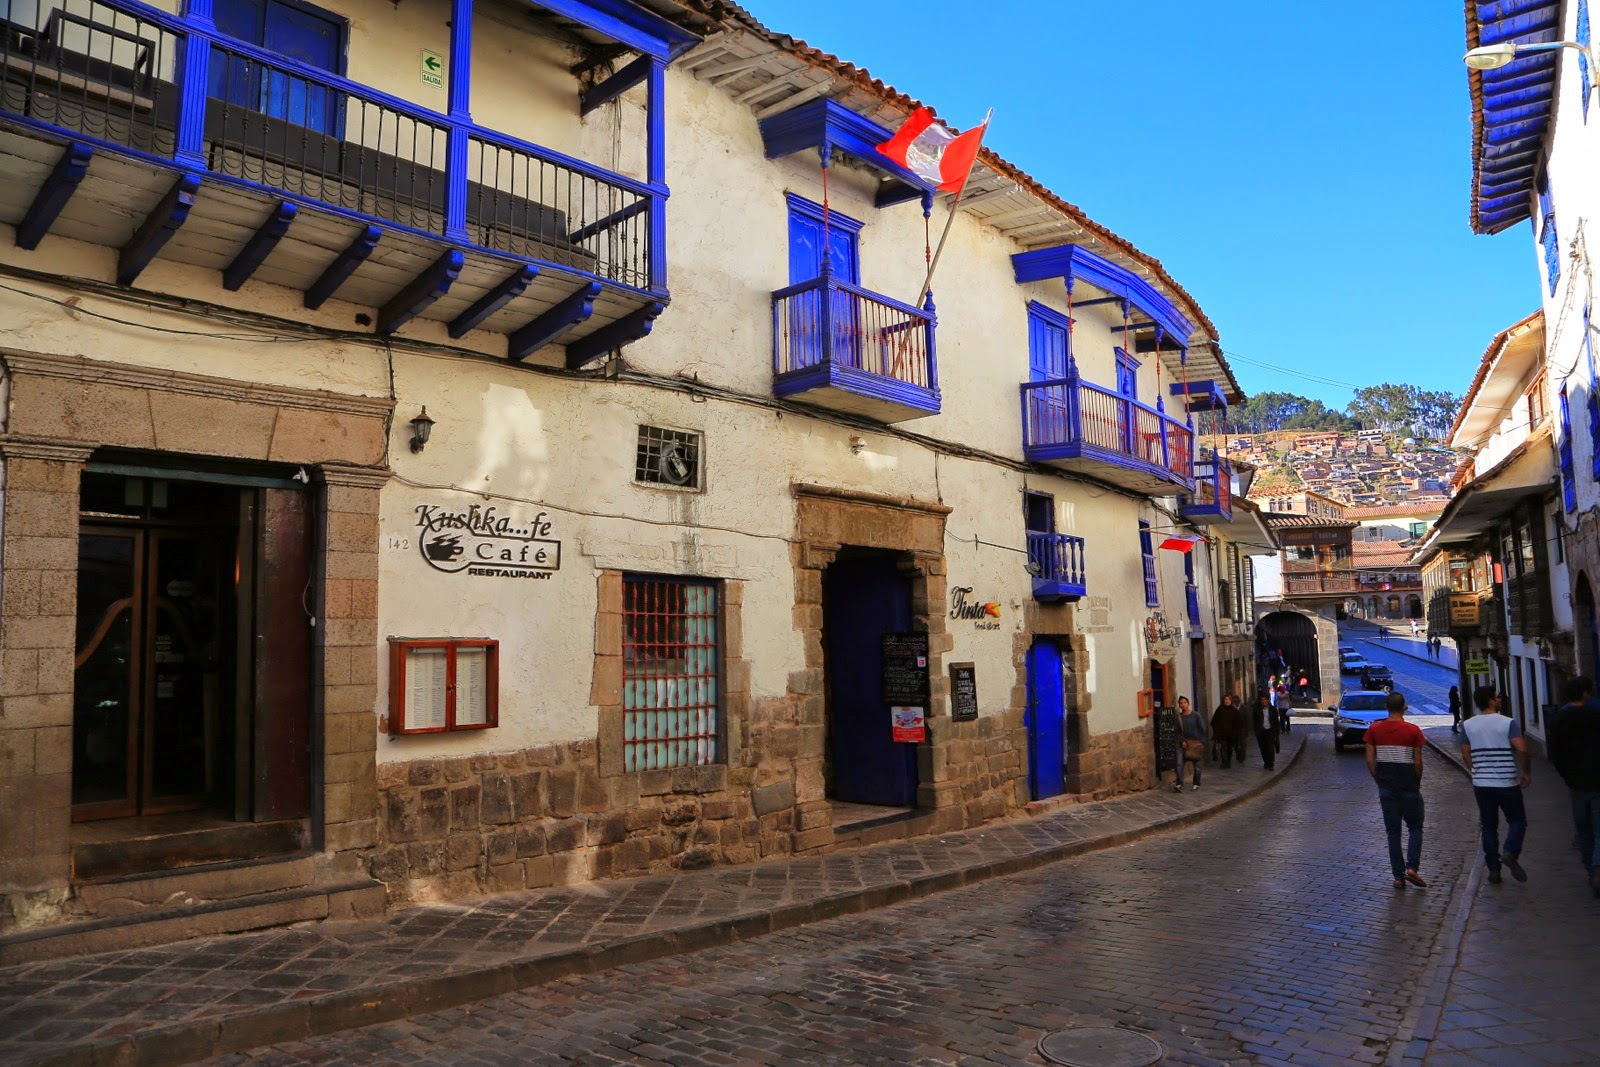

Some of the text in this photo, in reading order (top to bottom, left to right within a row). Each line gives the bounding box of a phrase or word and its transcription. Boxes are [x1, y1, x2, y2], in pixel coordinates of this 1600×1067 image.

[423, 74, 441, 85] SALIDA
[389, 537, 410, 550] 142
[475, 543, 547, 563] Café
[468, 568, 553, 580] RESTAURANT
[949, 586, 986, 620] Tinta
